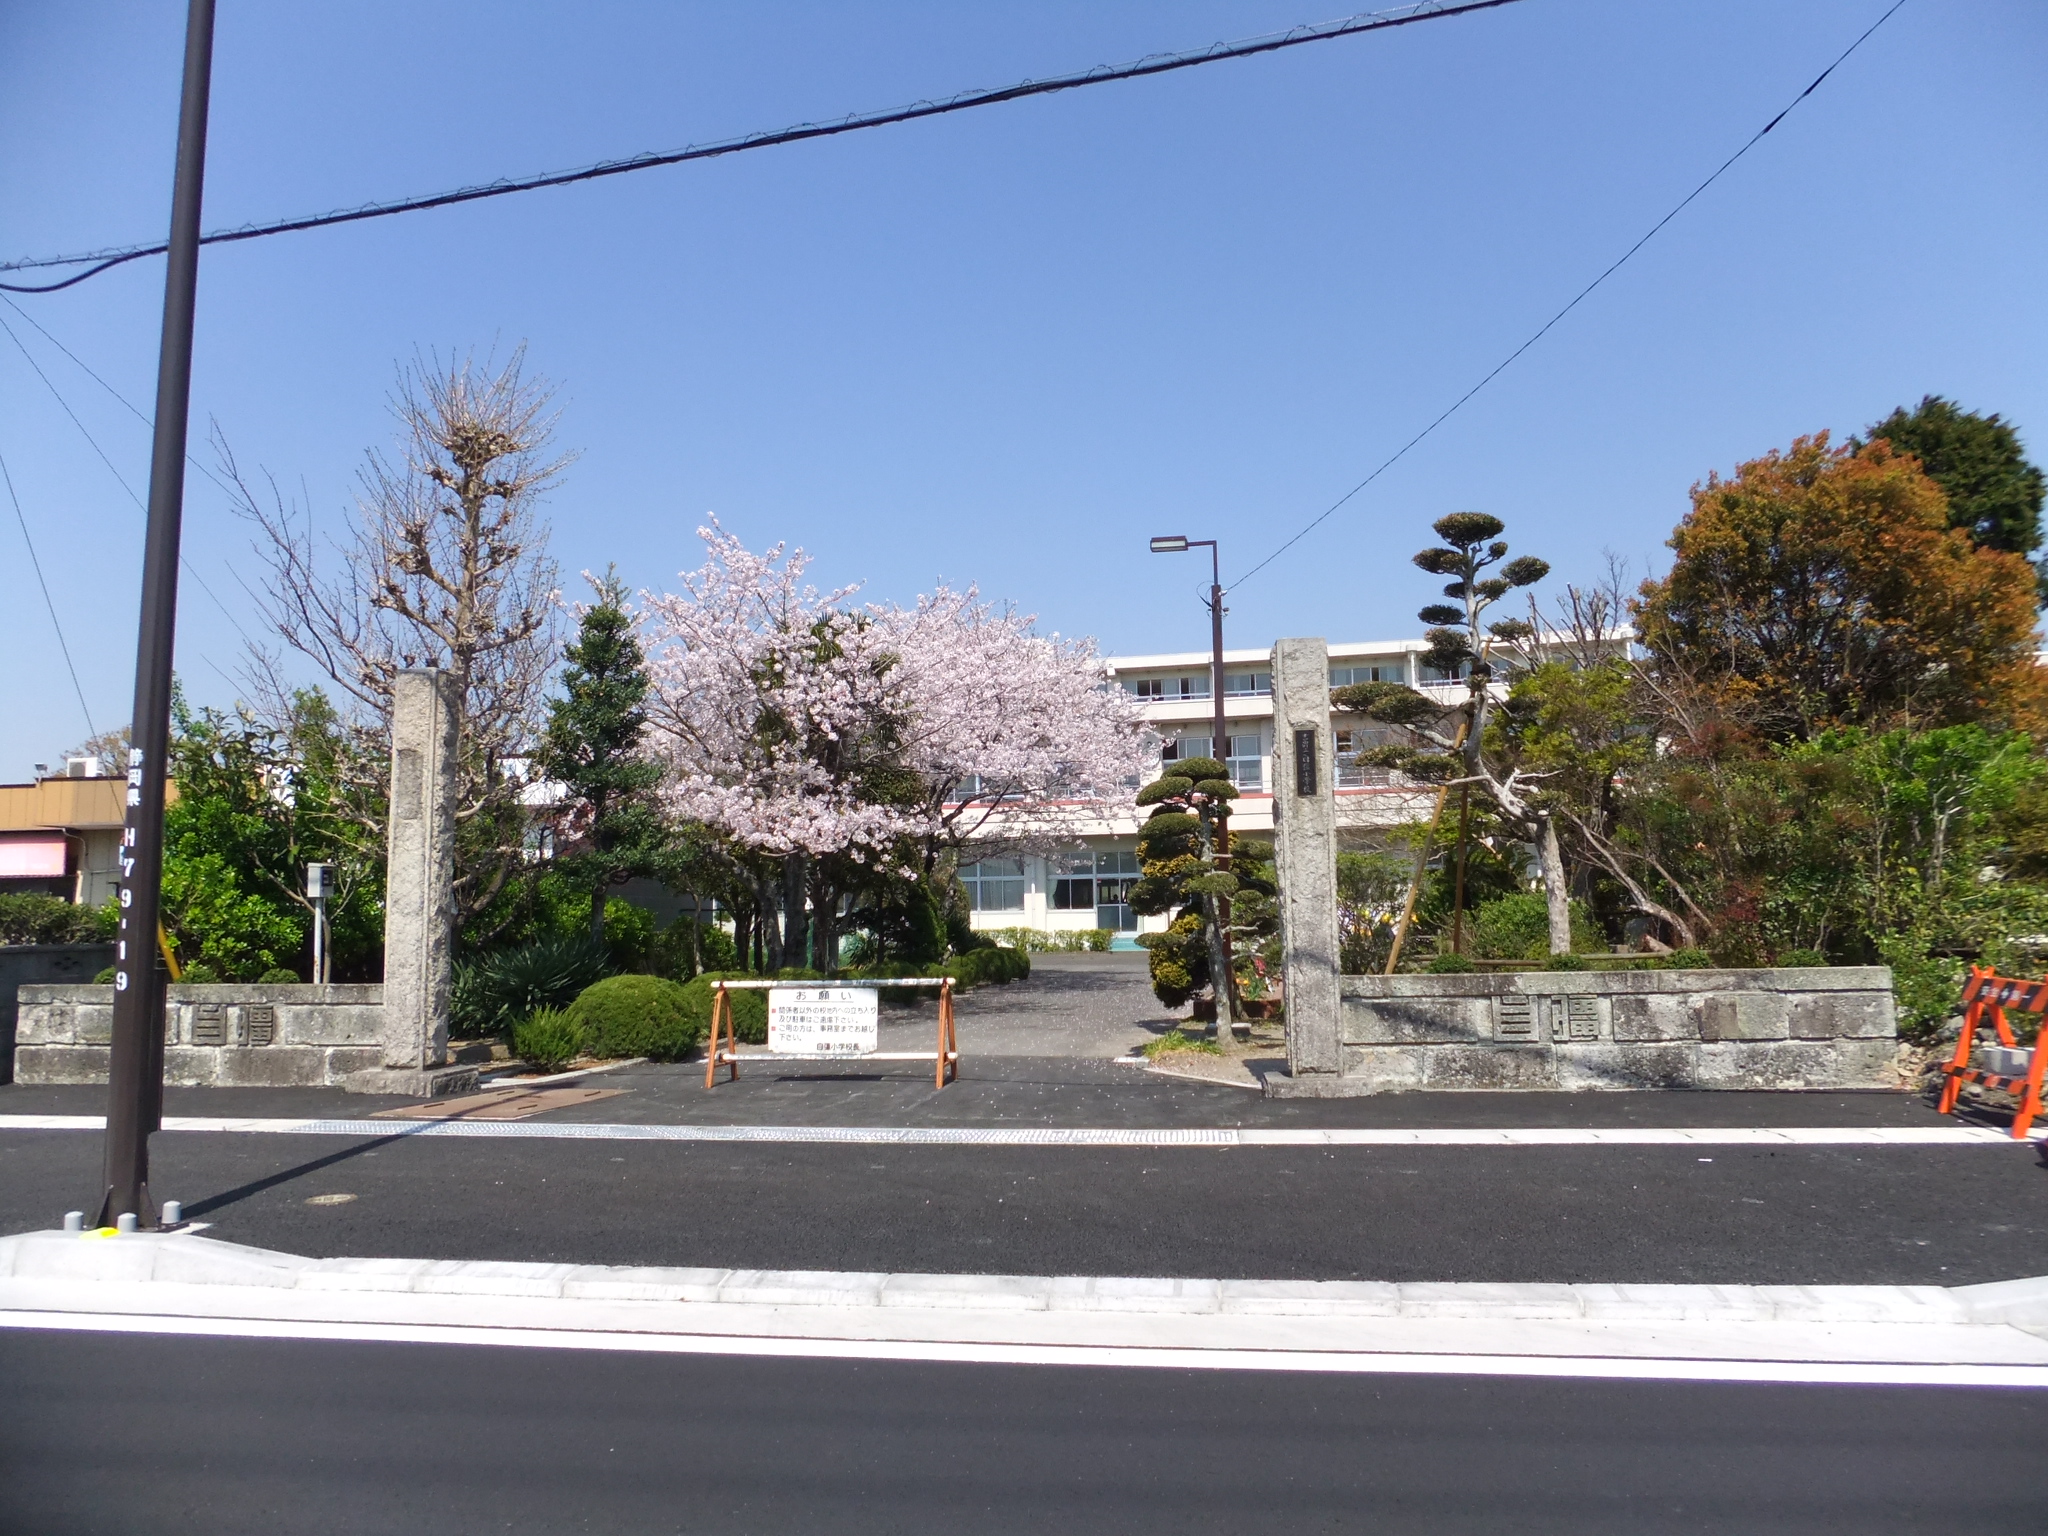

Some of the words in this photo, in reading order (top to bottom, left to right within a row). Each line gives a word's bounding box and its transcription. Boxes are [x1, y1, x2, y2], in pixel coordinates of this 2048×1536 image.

[126, 748, 144, 807] 静岡県
[796, 991, 852, 1001] お願い
[779, 1034, 802, 1042] 下さい。
